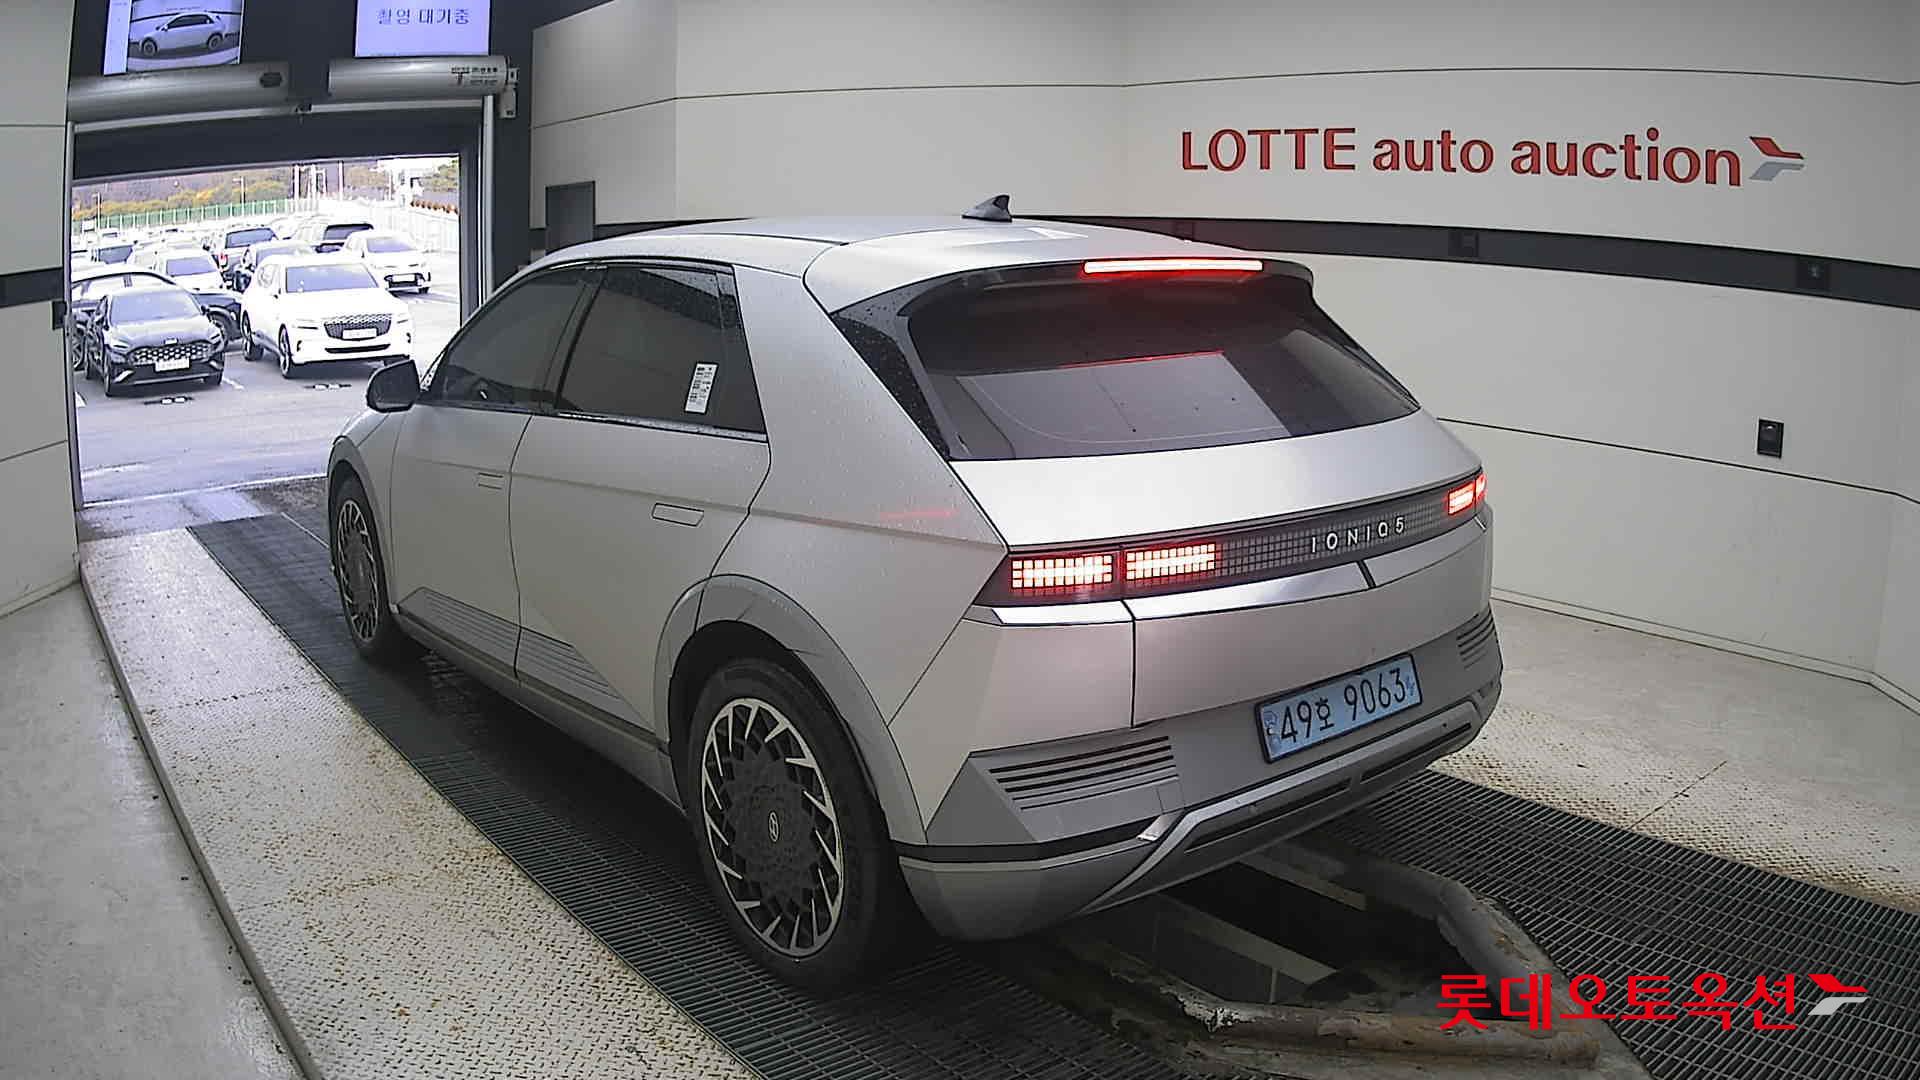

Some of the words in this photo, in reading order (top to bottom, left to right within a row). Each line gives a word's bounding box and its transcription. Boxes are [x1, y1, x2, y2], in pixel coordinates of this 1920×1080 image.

[1182, 127, 1356, 172] LOTTE
[1372, 129, 1494, 173] auto
[1510, 127, 1742, 186] auction
[1281, 697, 1334, 743] 49호
[1344, 667, 1406, 722] 9063
